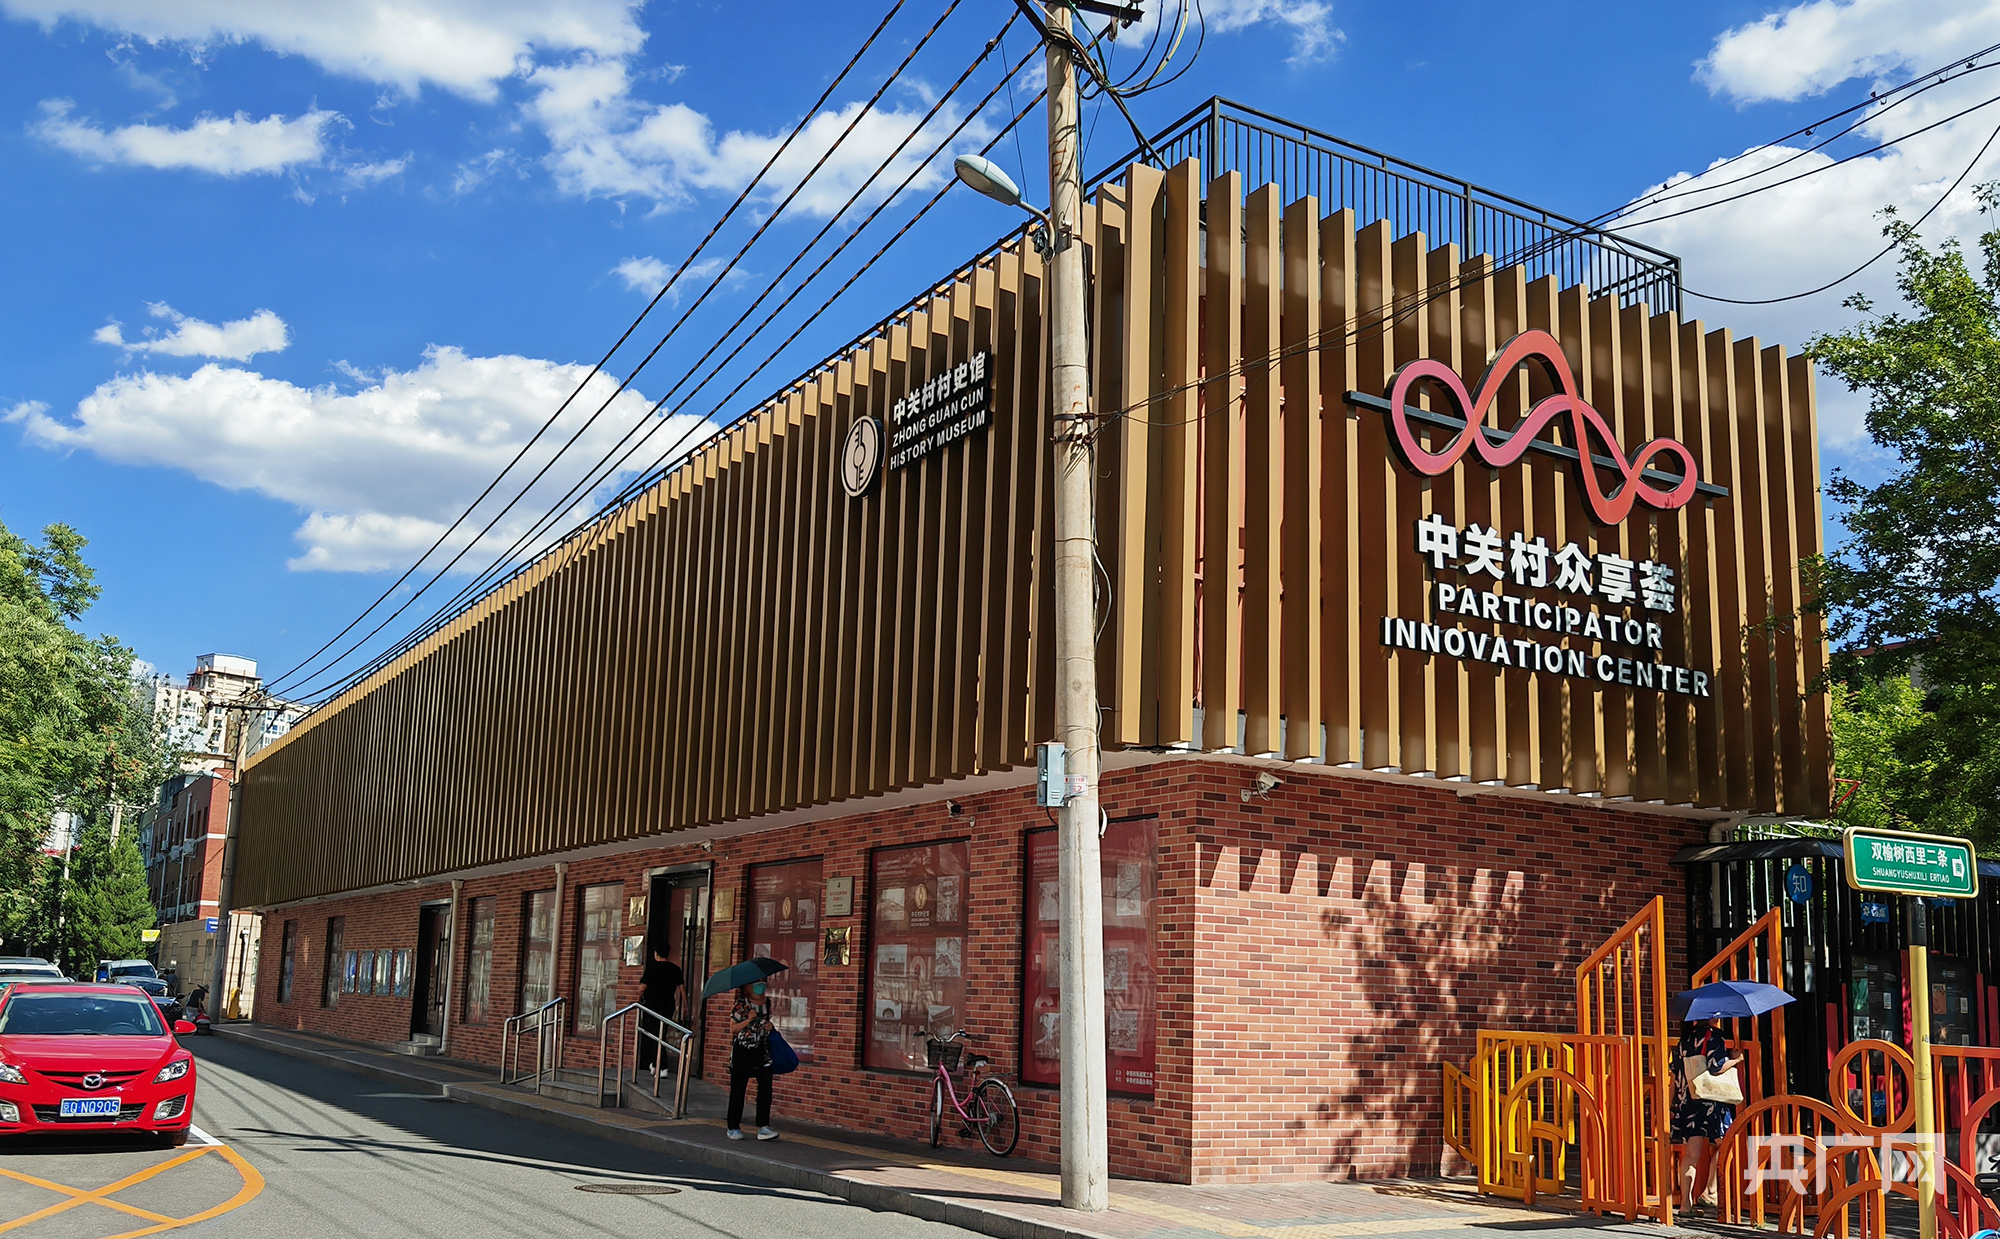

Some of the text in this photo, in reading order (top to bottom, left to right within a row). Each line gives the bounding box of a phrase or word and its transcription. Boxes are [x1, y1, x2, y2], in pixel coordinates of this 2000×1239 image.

[892, 387, 984, 449] ZHONG GUAN CUN
[893, 351, 986, 426] 中关村村史馆
[890, 410, 986, 470] HISTORY MUSEUM
[1417, 514, 1677, 614] 中关村众享荟
[1438, 583, 1664, 650] PARTICIPATOR
[1382, 616, 1711, 698] INNOVATION CENTER
[1792, 873, 1808, 894] 知
[1870, 842, 1948, 868] 双榆树西里二条
[1929, 872, 1950, 884] ERTIAO
